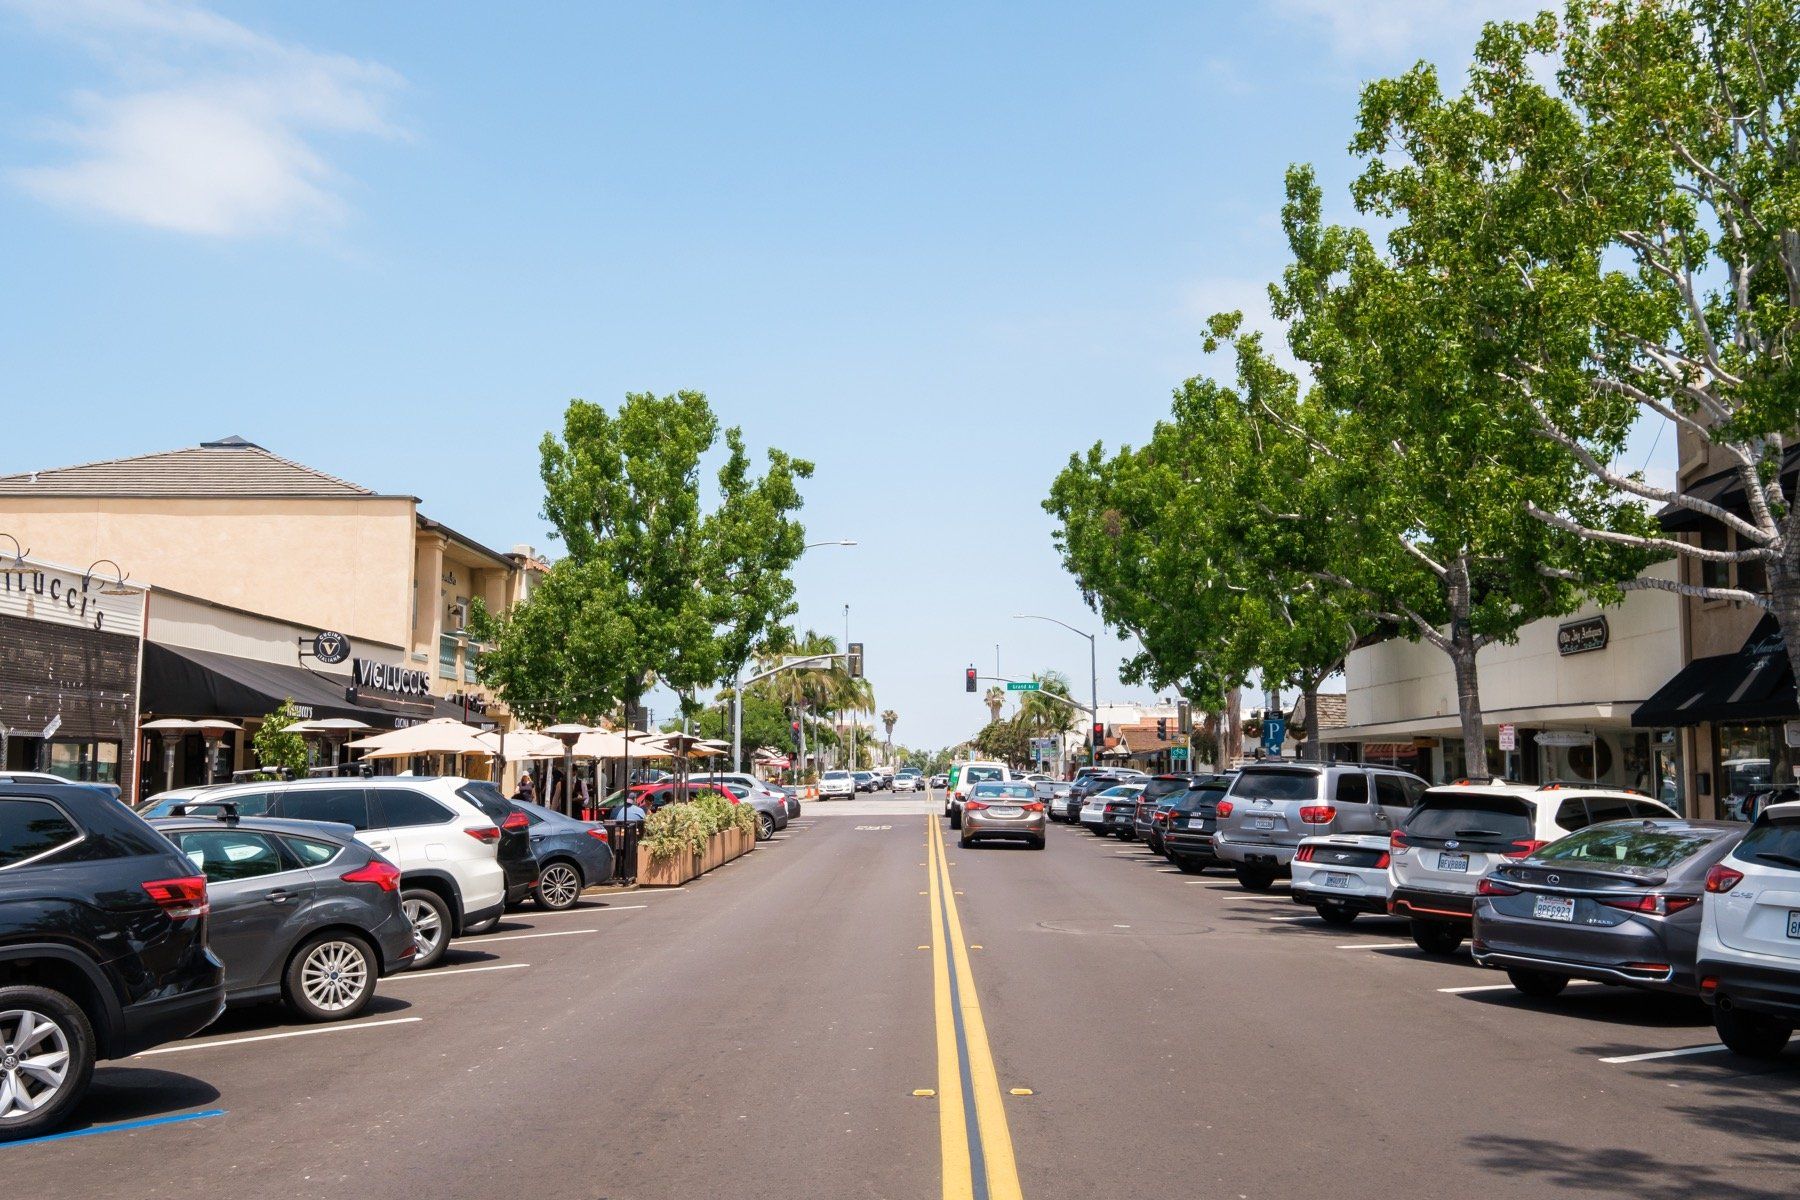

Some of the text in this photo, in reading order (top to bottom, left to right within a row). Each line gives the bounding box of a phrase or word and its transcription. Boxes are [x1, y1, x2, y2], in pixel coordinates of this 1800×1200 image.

[319, 631, 341, 640] CUCINA
[321, 642, 339, 655] V
[359, 658, 430, 695] VIGILUCCI'S
[1269, 722, 1280, 740] P
